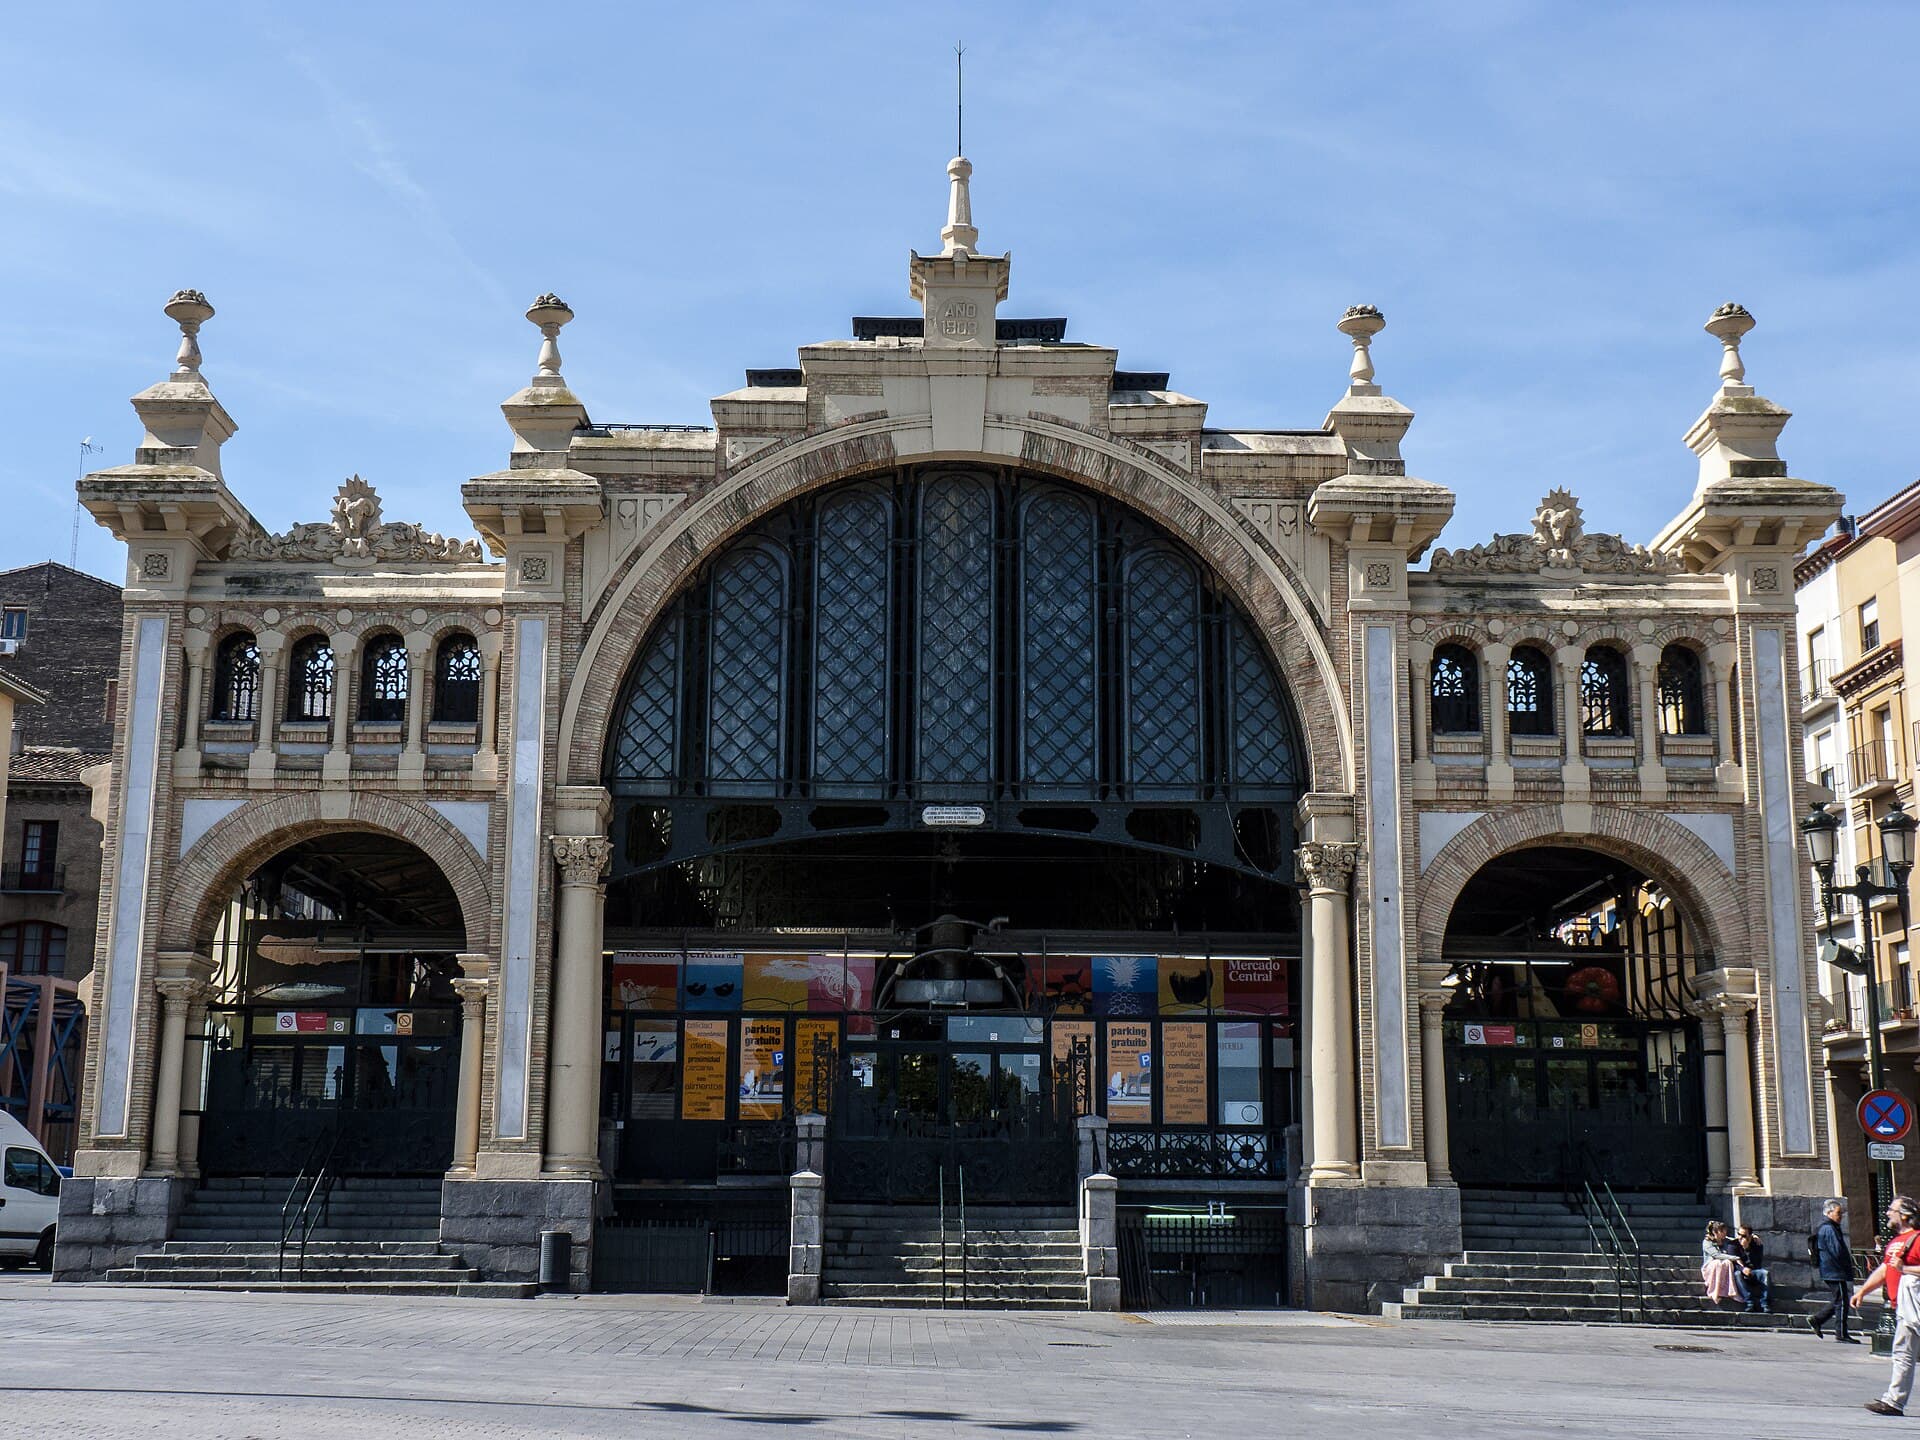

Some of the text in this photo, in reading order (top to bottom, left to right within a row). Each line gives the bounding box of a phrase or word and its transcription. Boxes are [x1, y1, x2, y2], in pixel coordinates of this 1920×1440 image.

[1228, 960, 1280, 971] Mercado
[1228, 971, 1272, 982] Central
[744, 1025, 781, 1036] parking
[1111, 1027, 1147, 1037] parking
[744, 1036, 781, 1047] gratuito
[1111, 1038, 1147, 1049] gratuito
